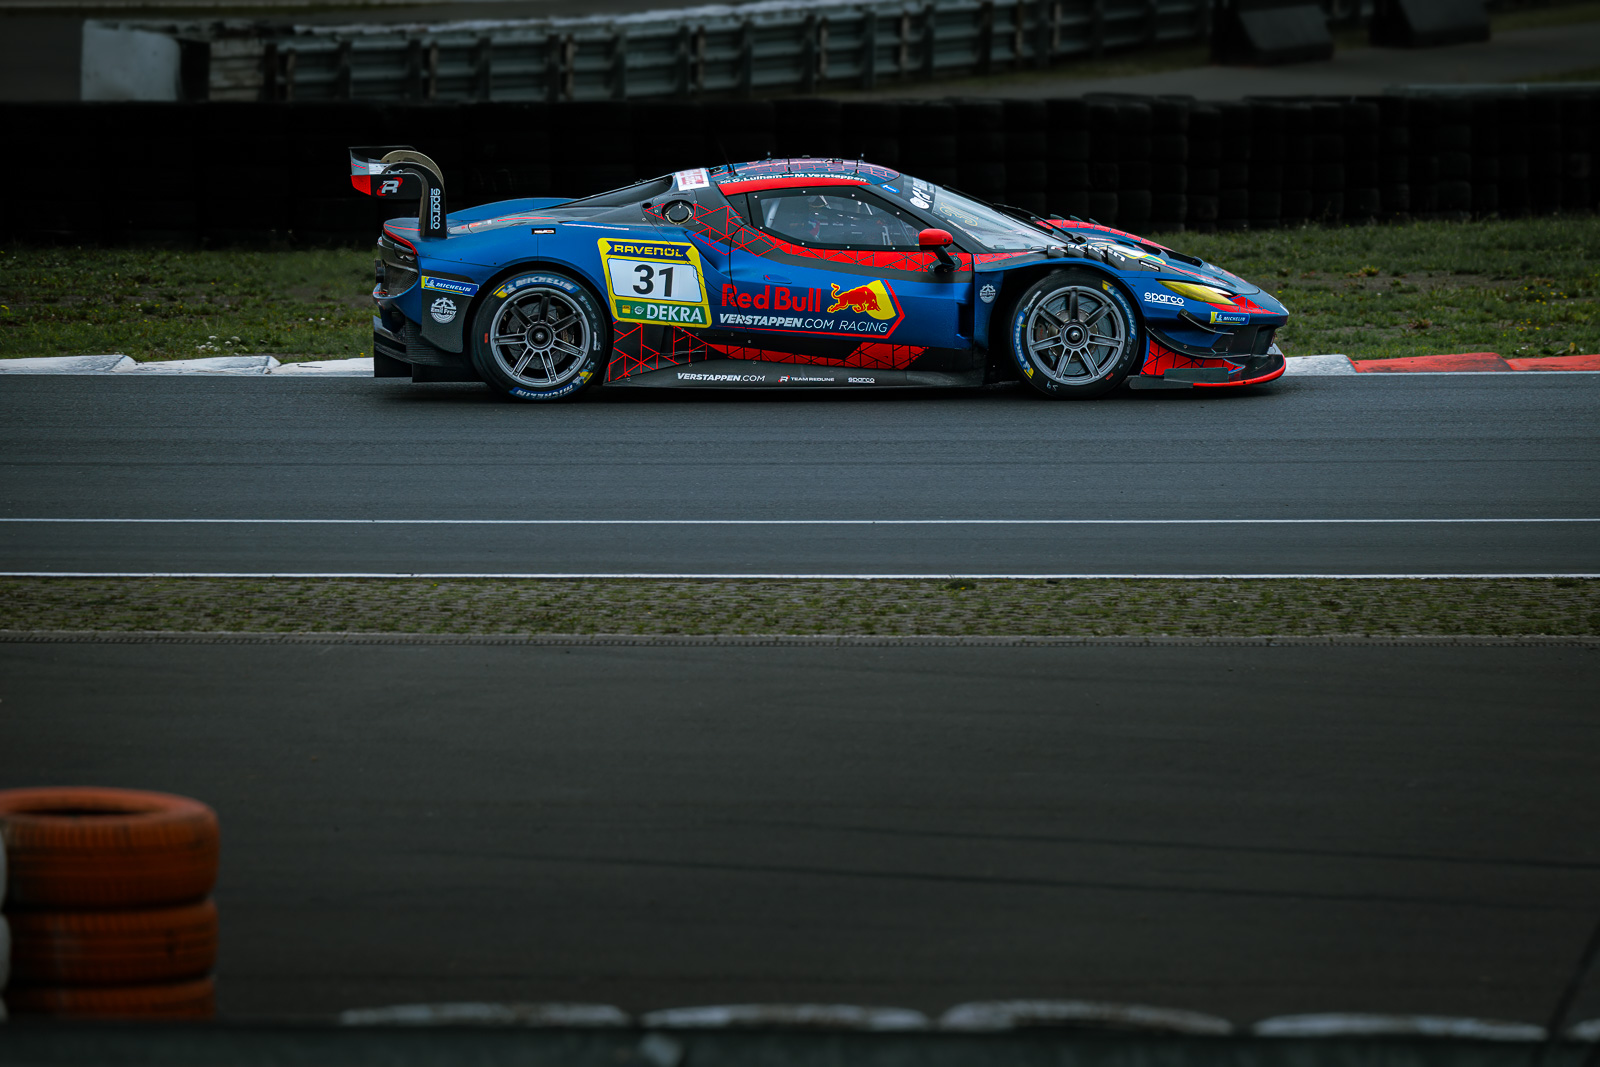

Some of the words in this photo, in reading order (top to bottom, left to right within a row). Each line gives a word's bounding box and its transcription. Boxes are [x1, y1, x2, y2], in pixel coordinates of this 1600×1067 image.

[430, 187, 441, 230] sparco
[435, 282, 472, 292] MICHELIN
[515, 276, 575, 291] MICHELIN
[632, 264, 674, 297] 31
[721, 283, 770, 310] Red
[774, 286, 822, 312] Bull
[1144, 292, 1185, 307] sparco
[646, 304, 703, 323] DEKRA
[719, 313, 835, 330] VERSTAPPEN.COM
[838, 320, 889, 333] RACING
[677, 372, 766, 382] VERSTAPPEN.COM
[848, 376, 875, 384] sparco
